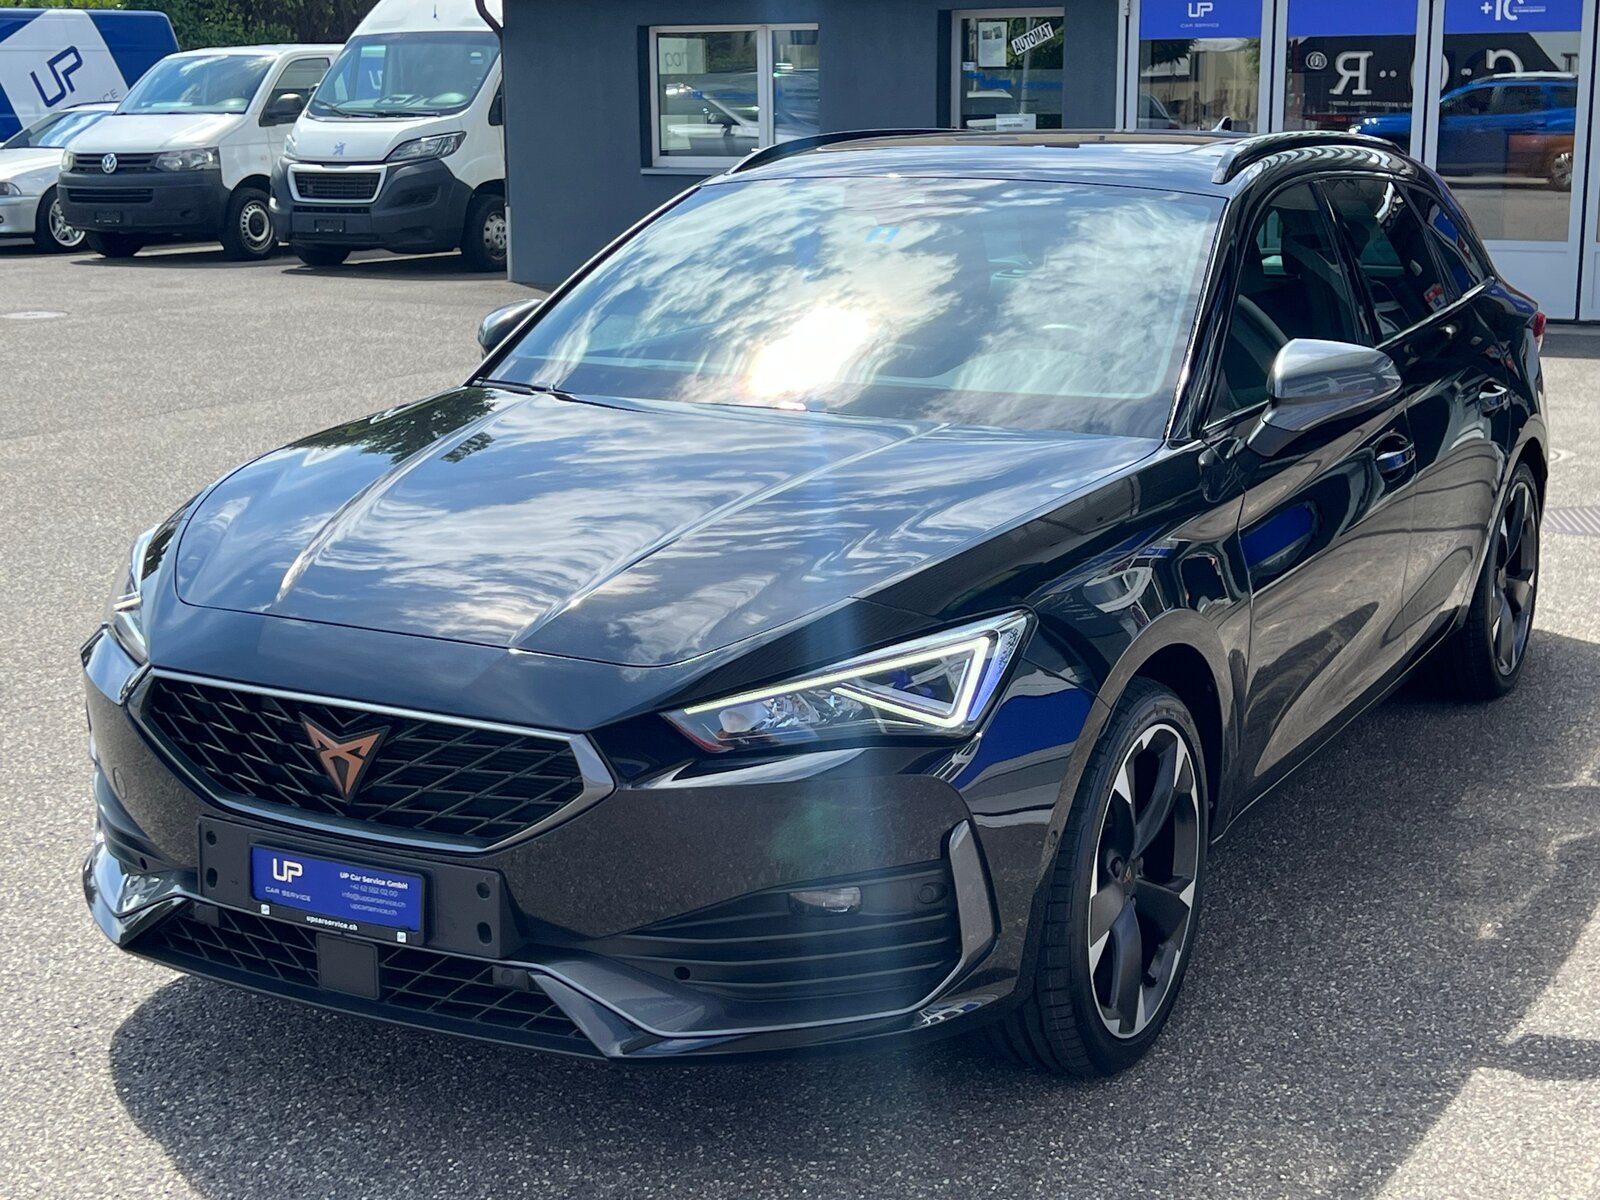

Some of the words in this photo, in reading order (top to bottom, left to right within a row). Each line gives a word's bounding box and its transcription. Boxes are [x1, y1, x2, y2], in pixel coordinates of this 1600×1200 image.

[1188, 2, 1213, 18] UP
[1014, 23, 1051, 53] AUTOMAT
[30, 46, 83, 107] UP
[272, 858, 303, 883] UP
[340, 871, 350, 879] UP
[350, 873, 361, 882] Car
[362, 875, 386, 886] Service
[386, 880, 409, 890] GmbH
[265, 886, 280, 894] CAR
[281, 890, 311, 902] SERVICE
[306, 915, 358, 931] upcarservice.ch
